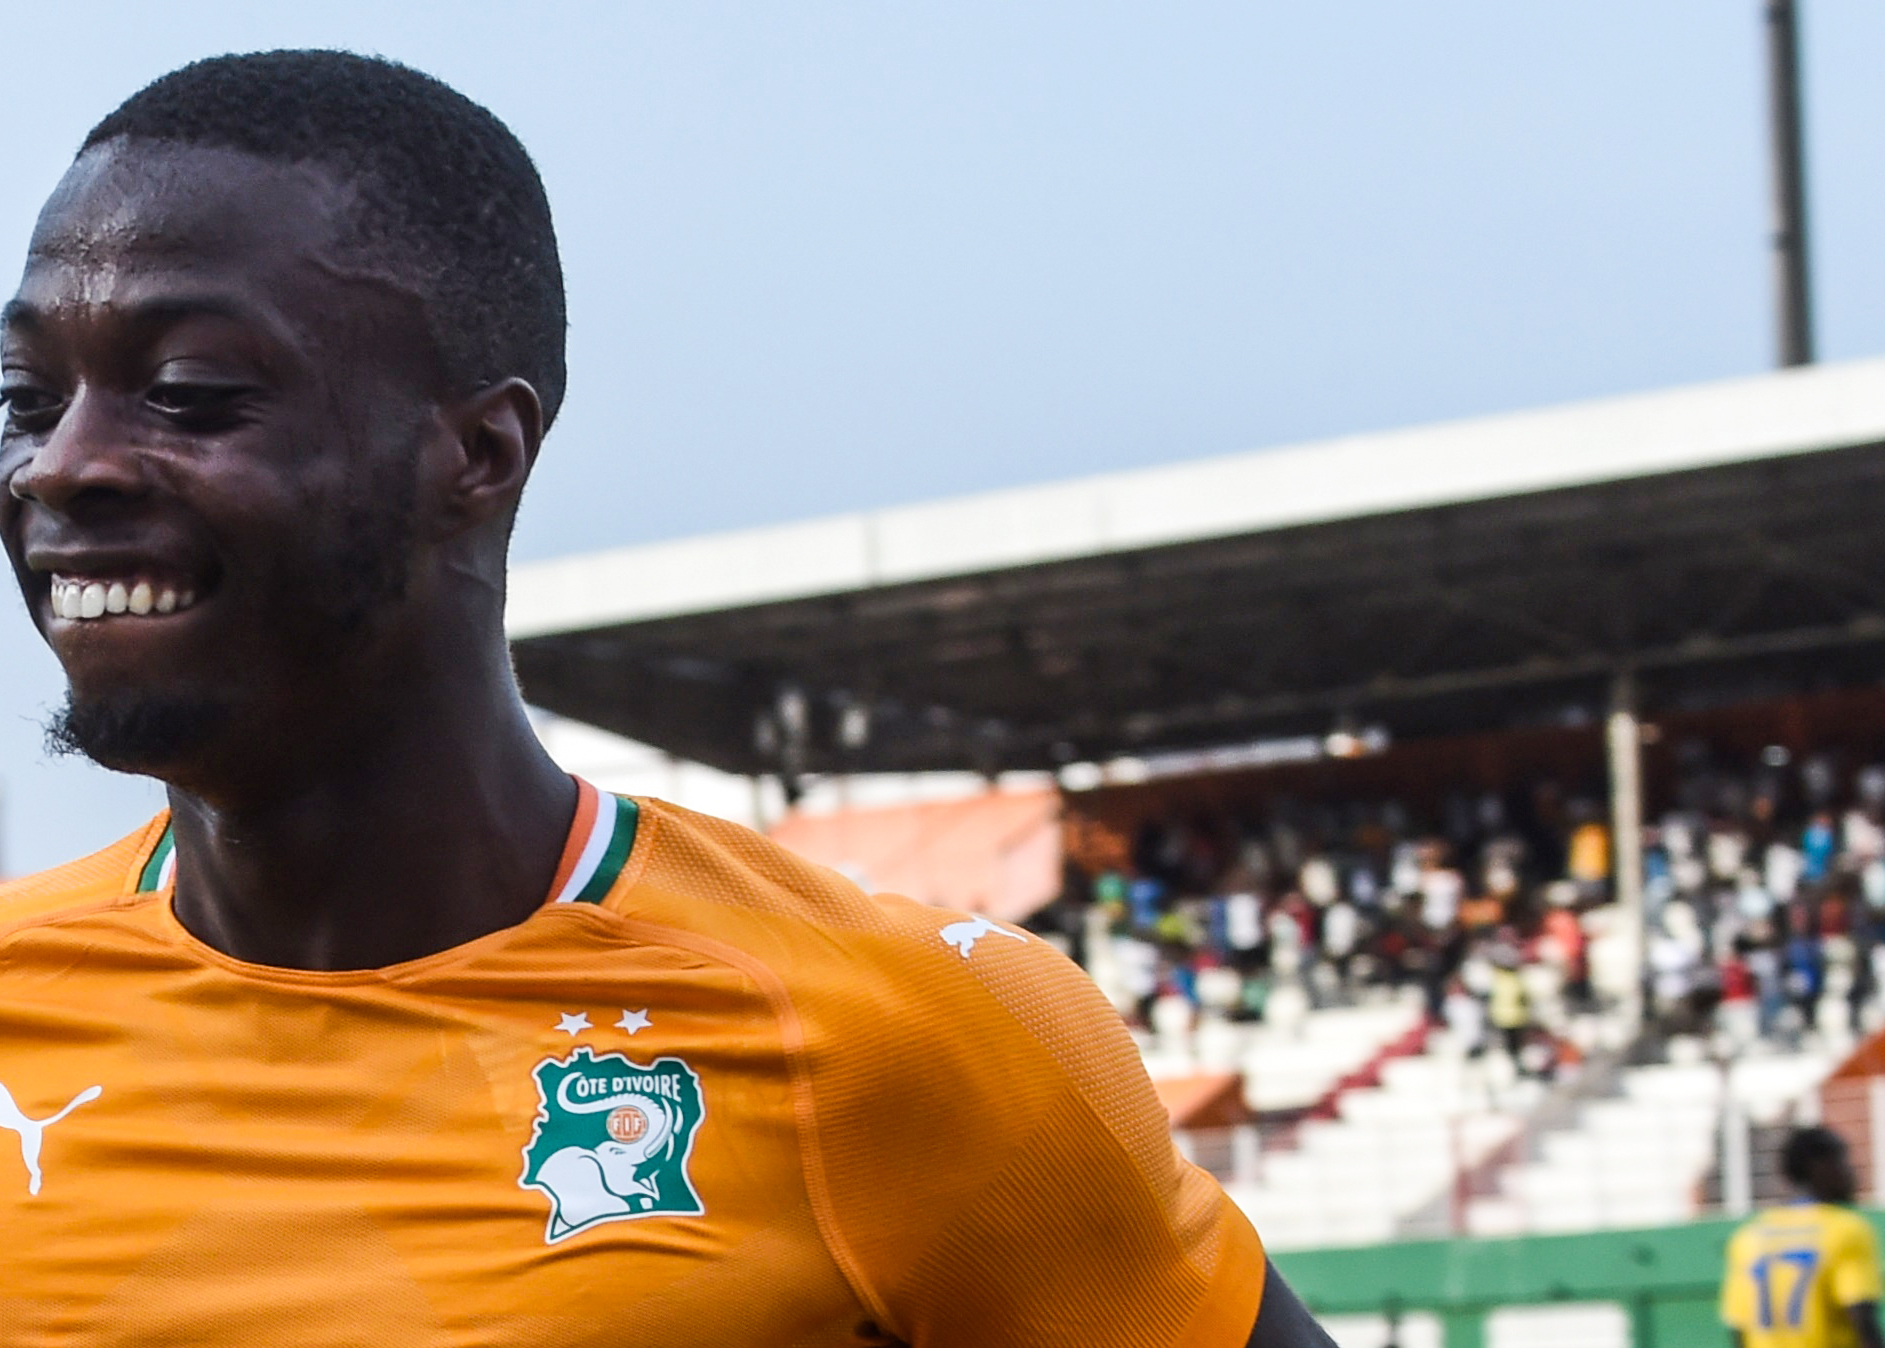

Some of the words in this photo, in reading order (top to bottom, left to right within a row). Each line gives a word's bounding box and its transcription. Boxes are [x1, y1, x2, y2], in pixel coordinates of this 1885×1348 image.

[612, 1074, 682, 1102] D'IVOIRE
[612, 1116, 642, 1133] FIF
[1749, 1250, 1818, 1329] 17
